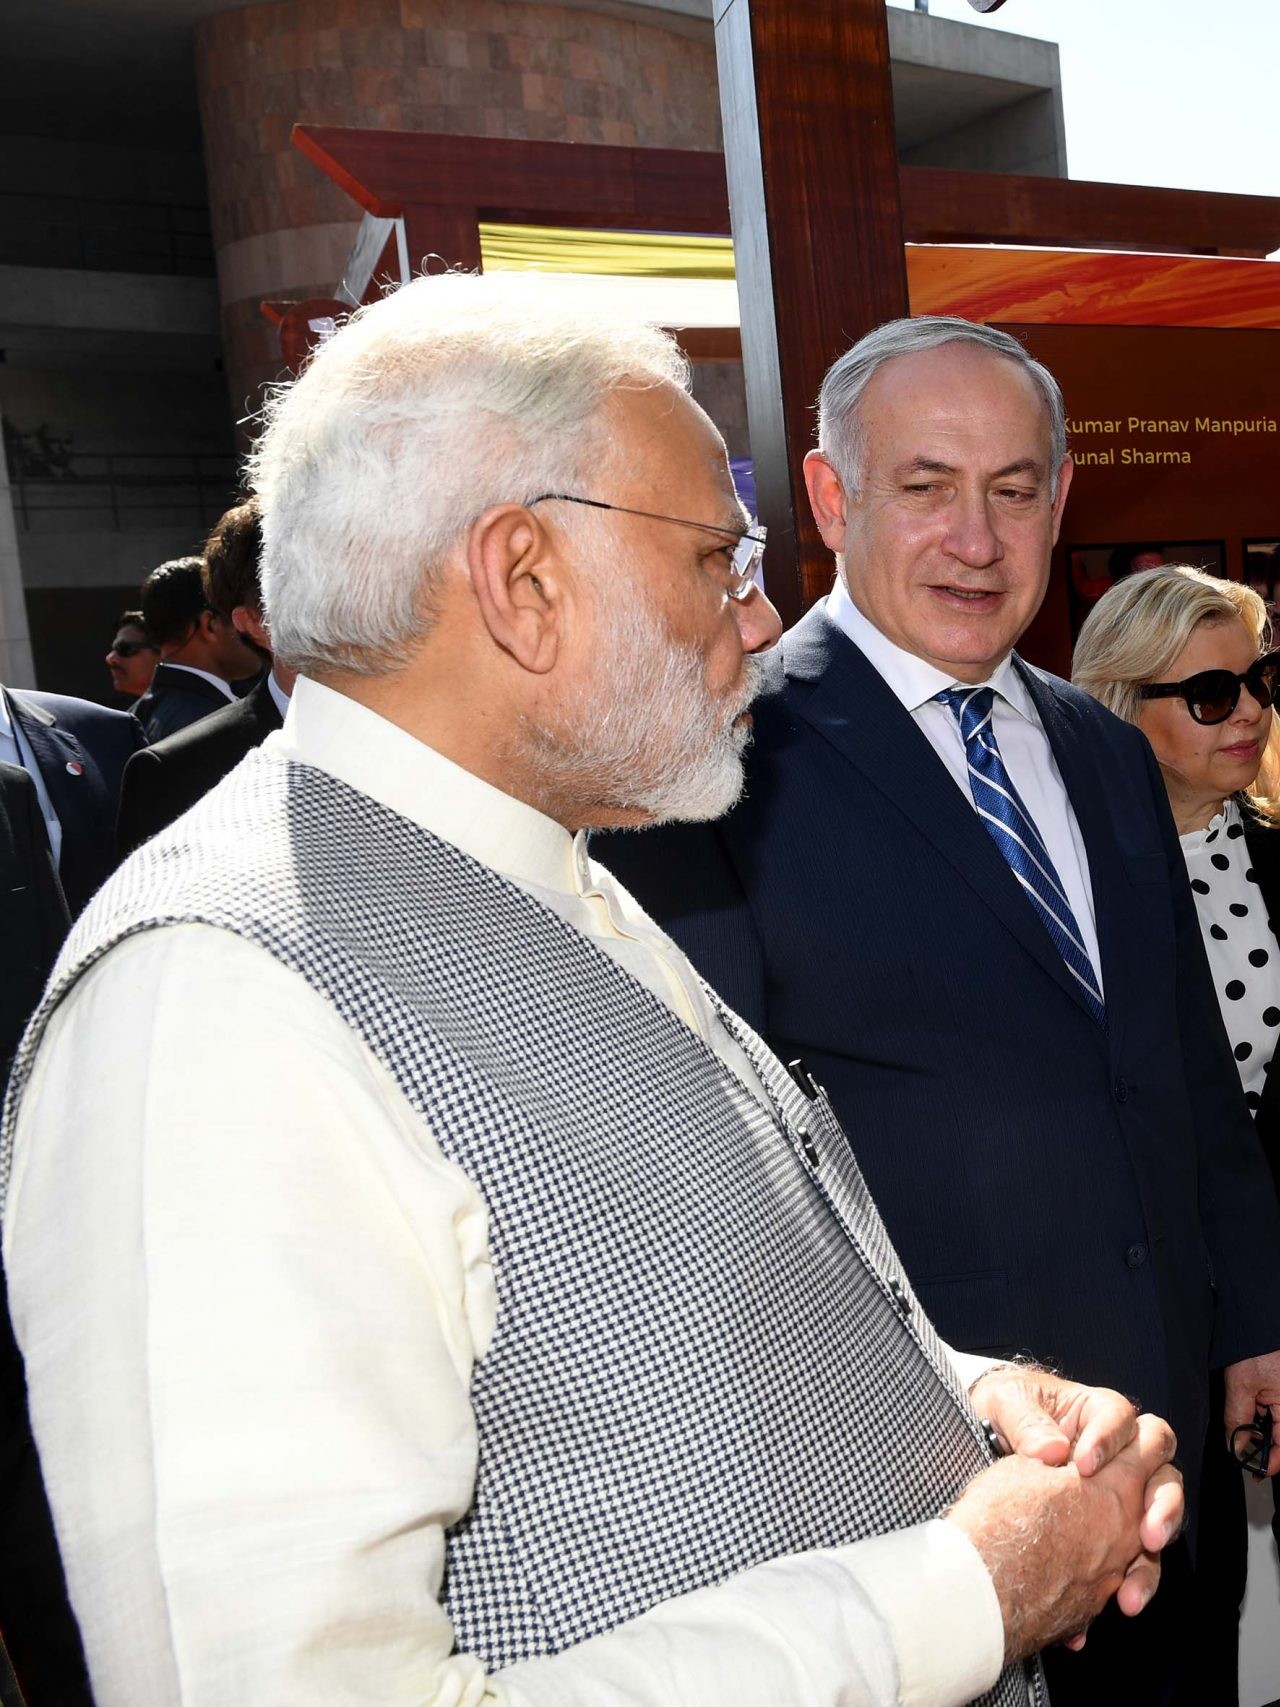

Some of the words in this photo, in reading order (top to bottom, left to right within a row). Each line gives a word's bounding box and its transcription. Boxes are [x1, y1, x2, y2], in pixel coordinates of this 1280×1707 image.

[1128, 417, 1190, 433] Pranav
[1195, 416, 1277, 436] Manpuria
[1121, 448, 1192, 464] Sharma
